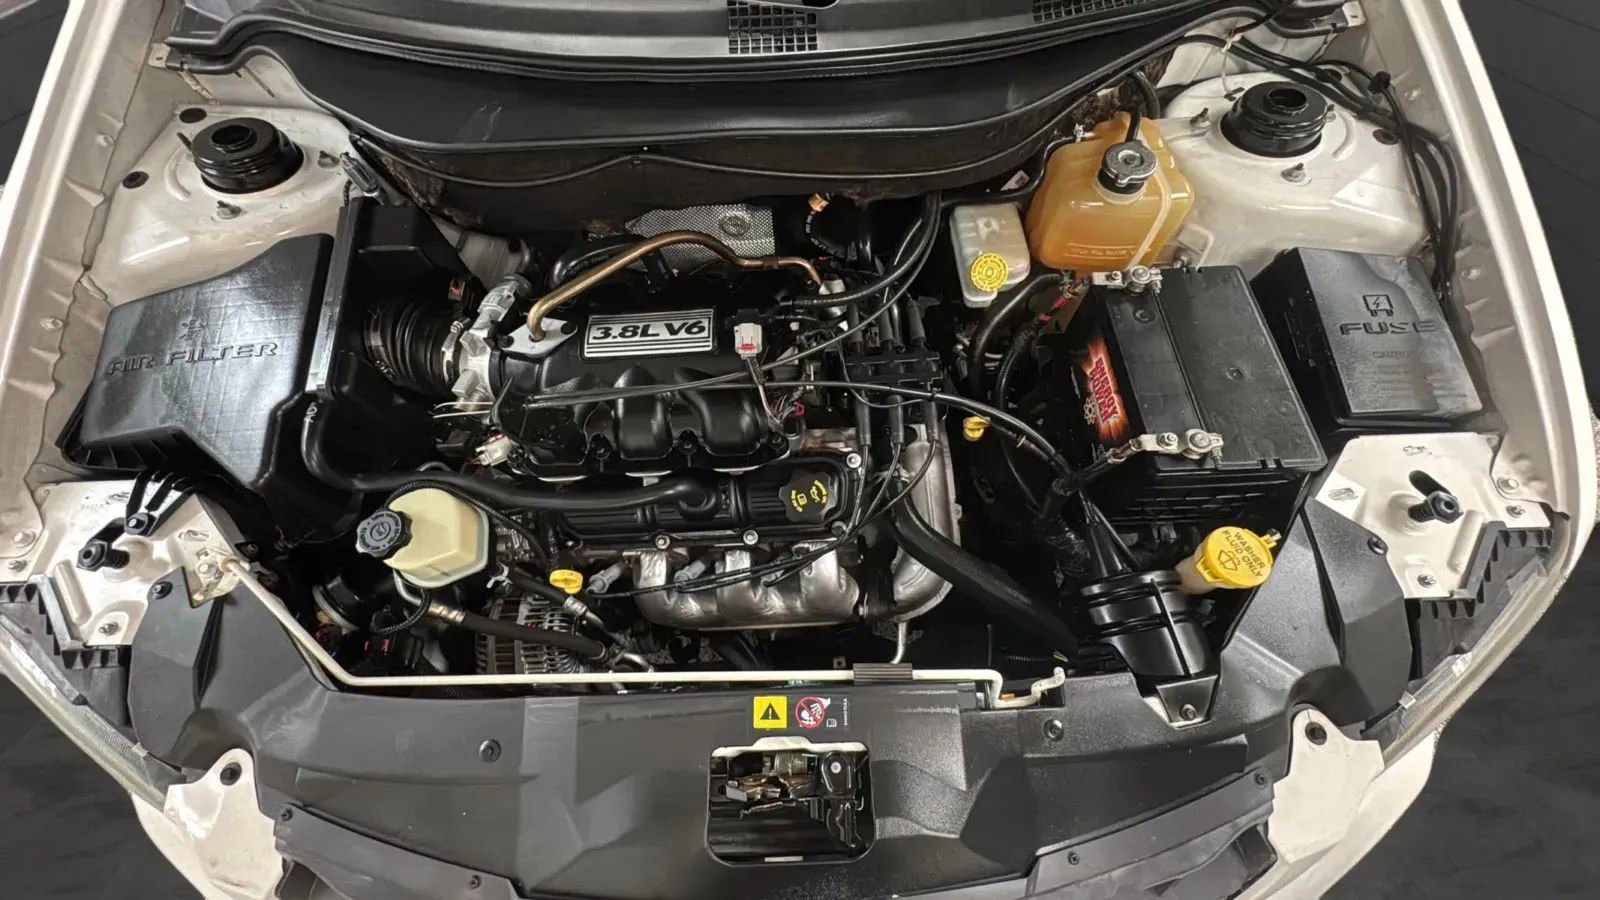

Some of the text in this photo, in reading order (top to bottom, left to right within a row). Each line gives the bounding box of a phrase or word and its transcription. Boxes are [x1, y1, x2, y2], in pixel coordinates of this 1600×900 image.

[592, 320, 706, 340] 3.8L V6
[1339, 320, 1438, 335] FUSE
[106, 342, 278, 376] AIR FILTER
[1089, 368, 1111, 423] POWER
[1095, 356, 1120, 418] ENERGY
[1222, 530, 1263, 577] FLUID ONLY
[1234, 532, 1266, 569] WASHER
